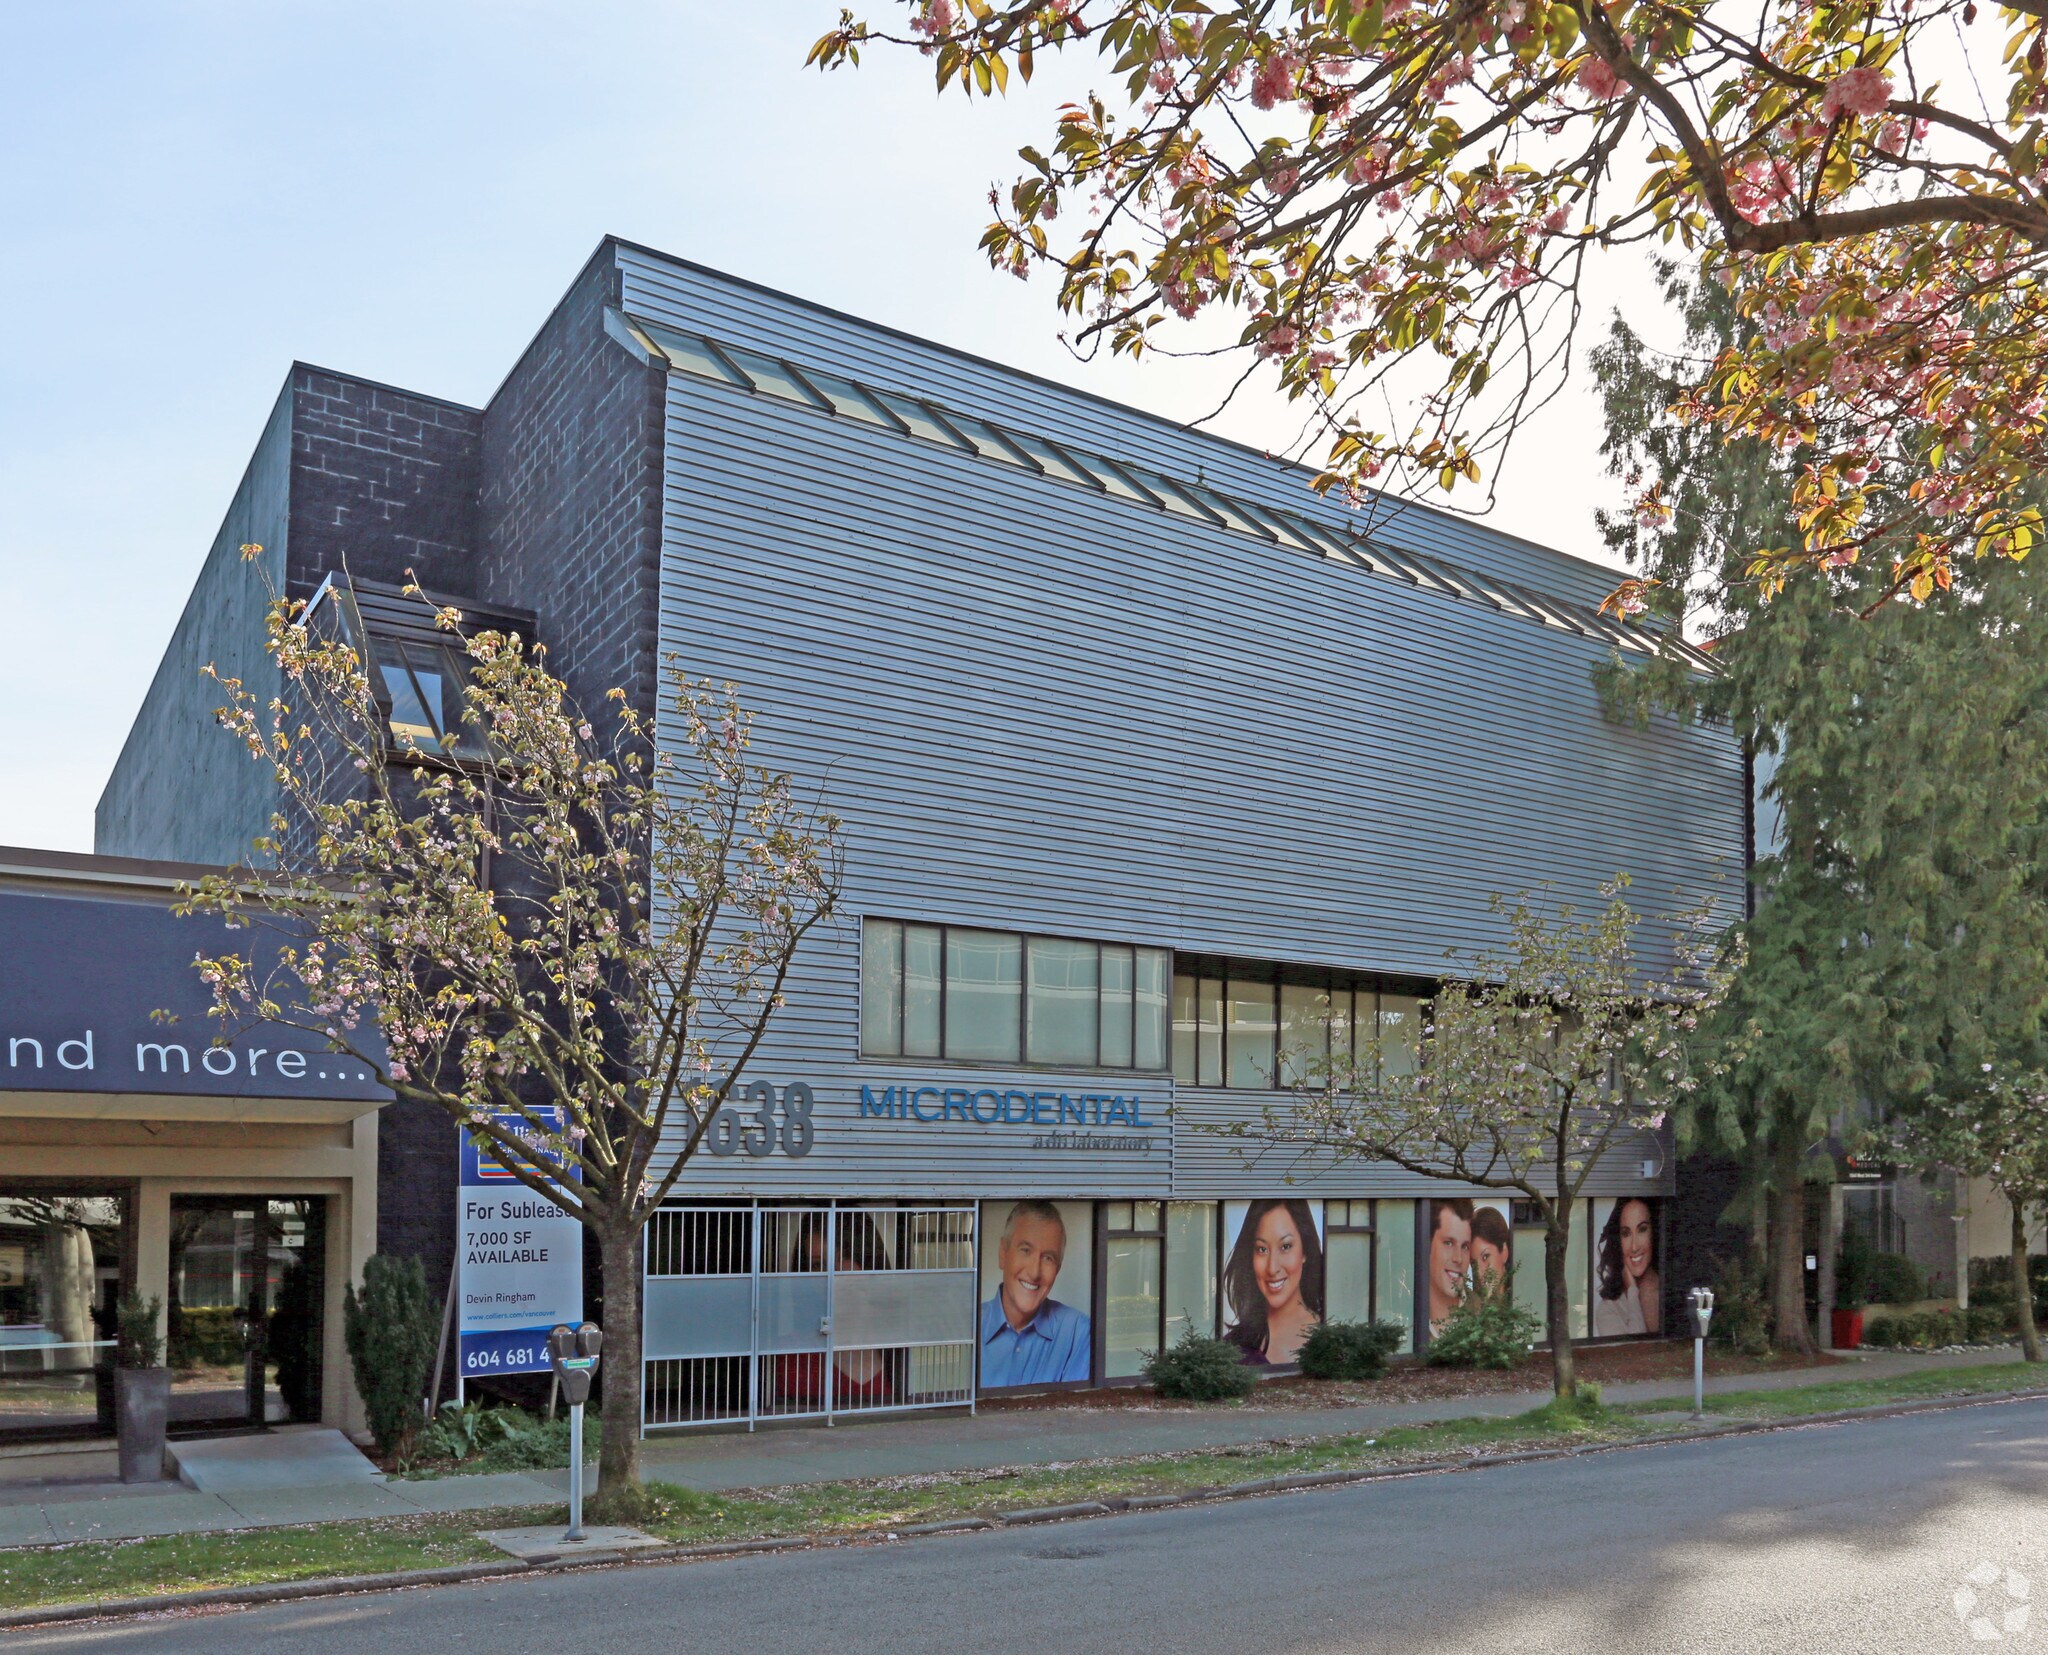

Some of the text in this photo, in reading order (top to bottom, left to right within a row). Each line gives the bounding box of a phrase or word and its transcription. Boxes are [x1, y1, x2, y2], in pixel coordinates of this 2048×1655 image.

[861, 1084, 1154, 1127] MICRODENTAL
[1072, 1131, 1154, 1157] laboratory
[466, 1202, 494, 1220] For
[467, 1231, 532, 1248] 7,000 SF
[467, 1249, 548, 1264] AVAILABLE
[466, 1292, 536, 1304] Devin Ringham
[467, 1310, 557, 1321] www.colliers.com/vancouver
[467, 1351, 500, 1368] 604
[505, 1348, 534, 1365] 681
